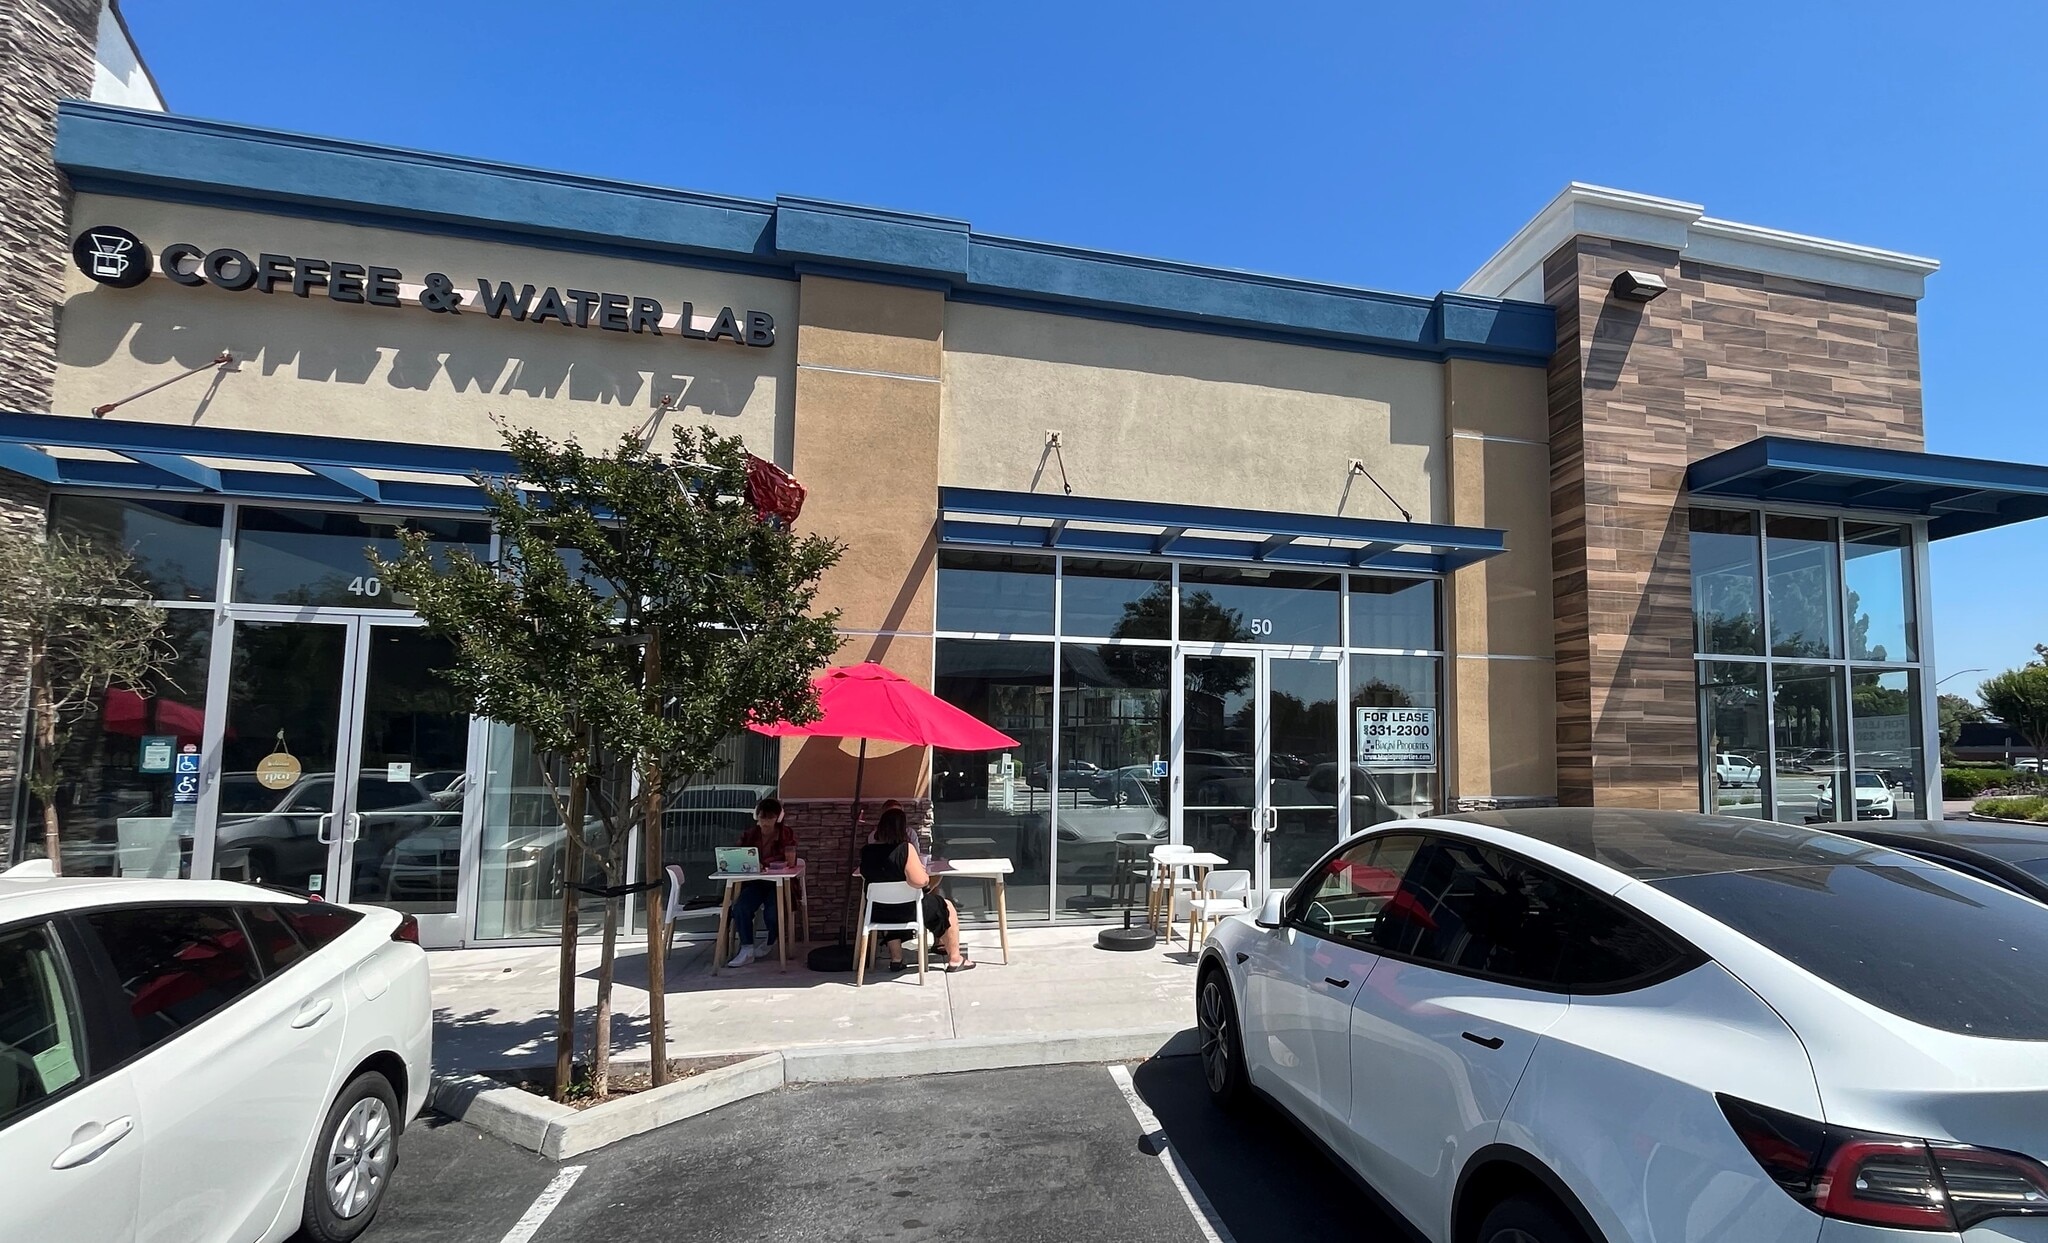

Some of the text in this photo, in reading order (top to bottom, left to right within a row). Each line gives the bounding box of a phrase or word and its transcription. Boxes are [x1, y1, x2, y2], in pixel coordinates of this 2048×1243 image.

[160, 243, 776, 348] COFFEE & WATER LAB
[347, 576, 381, 597] 40
[1250, 618, 1273, 635] 50
[1364, 712, 1429, 722] FOR LEASE
[1369, 725, 1430, 736] 331-2300
